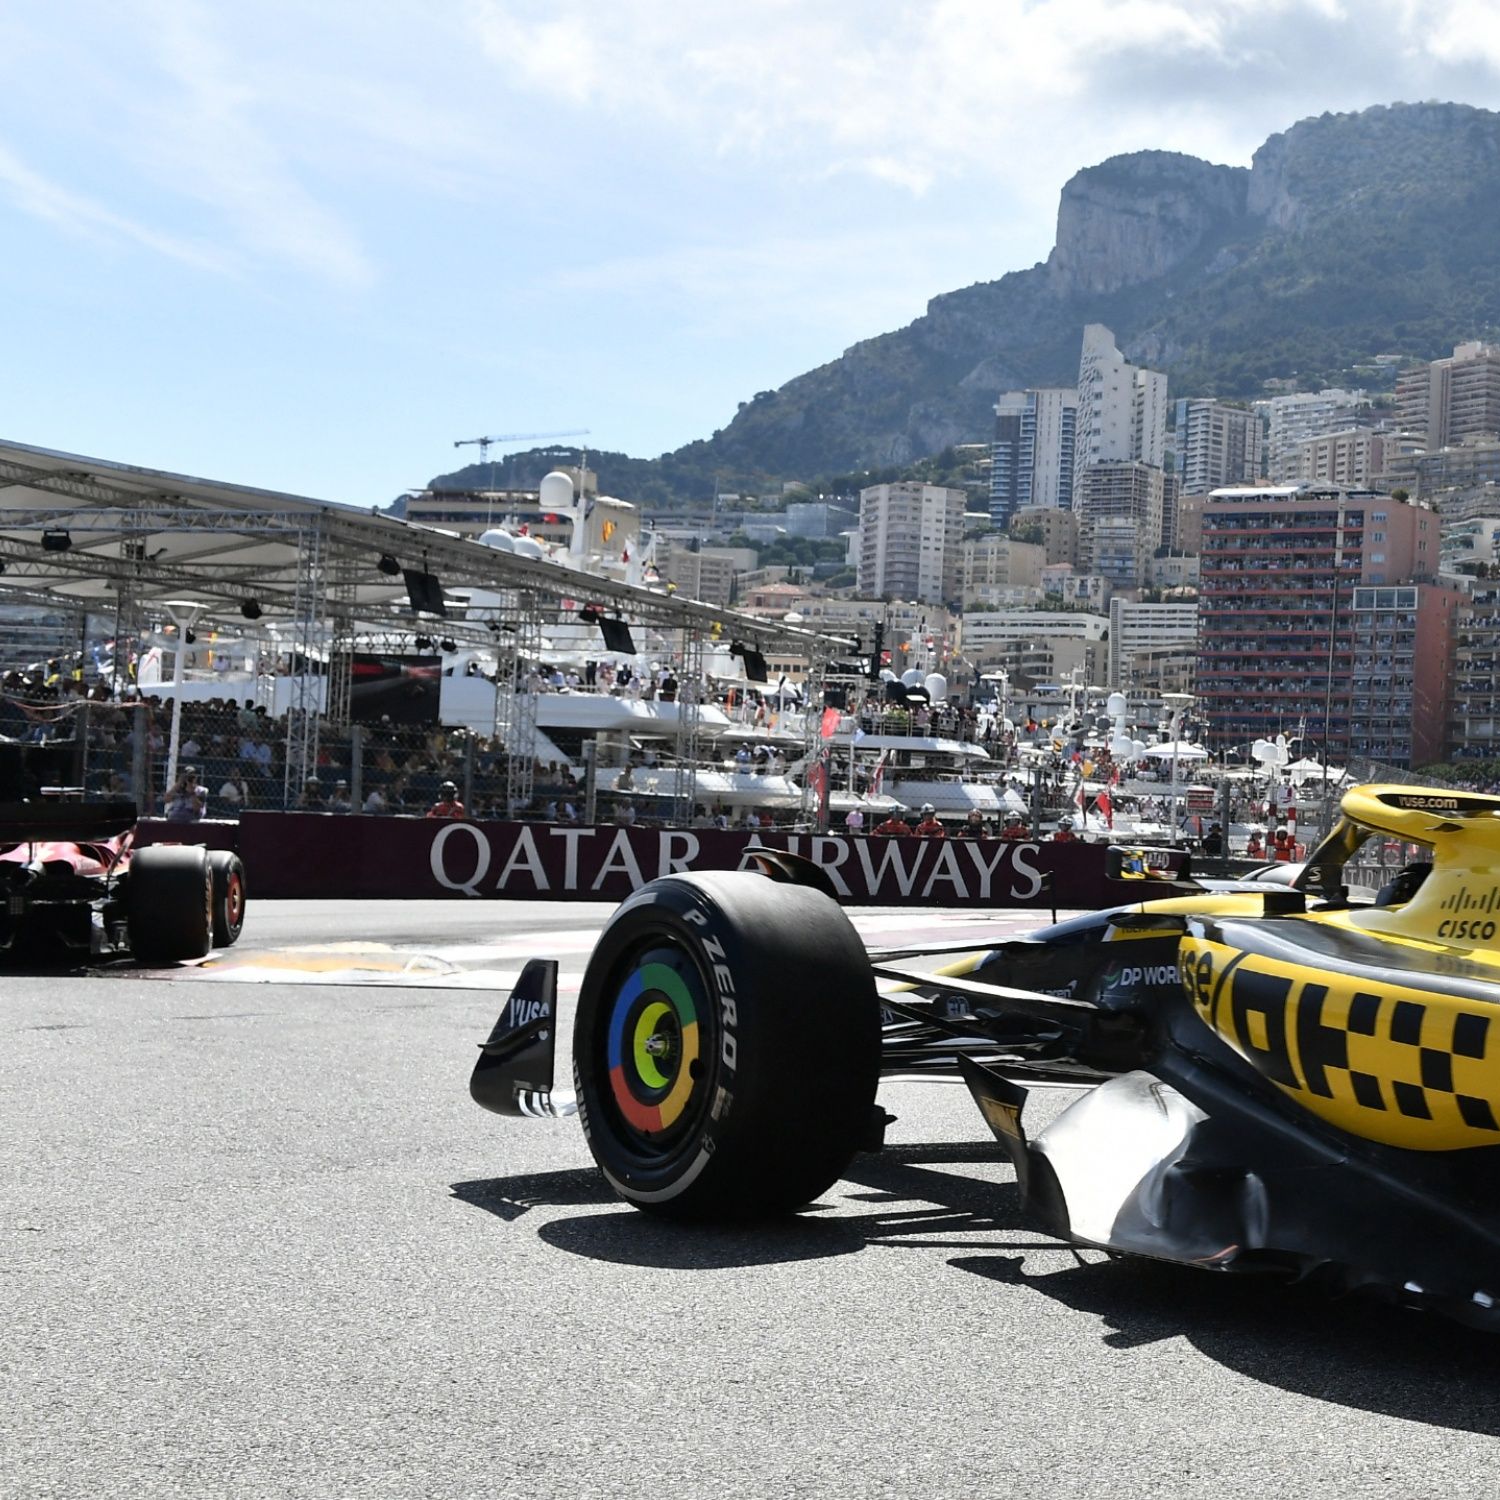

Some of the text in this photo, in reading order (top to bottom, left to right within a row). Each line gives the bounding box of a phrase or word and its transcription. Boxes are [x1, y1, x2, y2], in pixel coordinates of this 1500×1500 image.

[429, 822, 700, 897] QATAR
[1437, 919, 1496, 940] CISCO
[682, 908, 708, 927] P
[701, 934, 738, 1072] ZERO
[1120, 966, 1143, 986] DP
